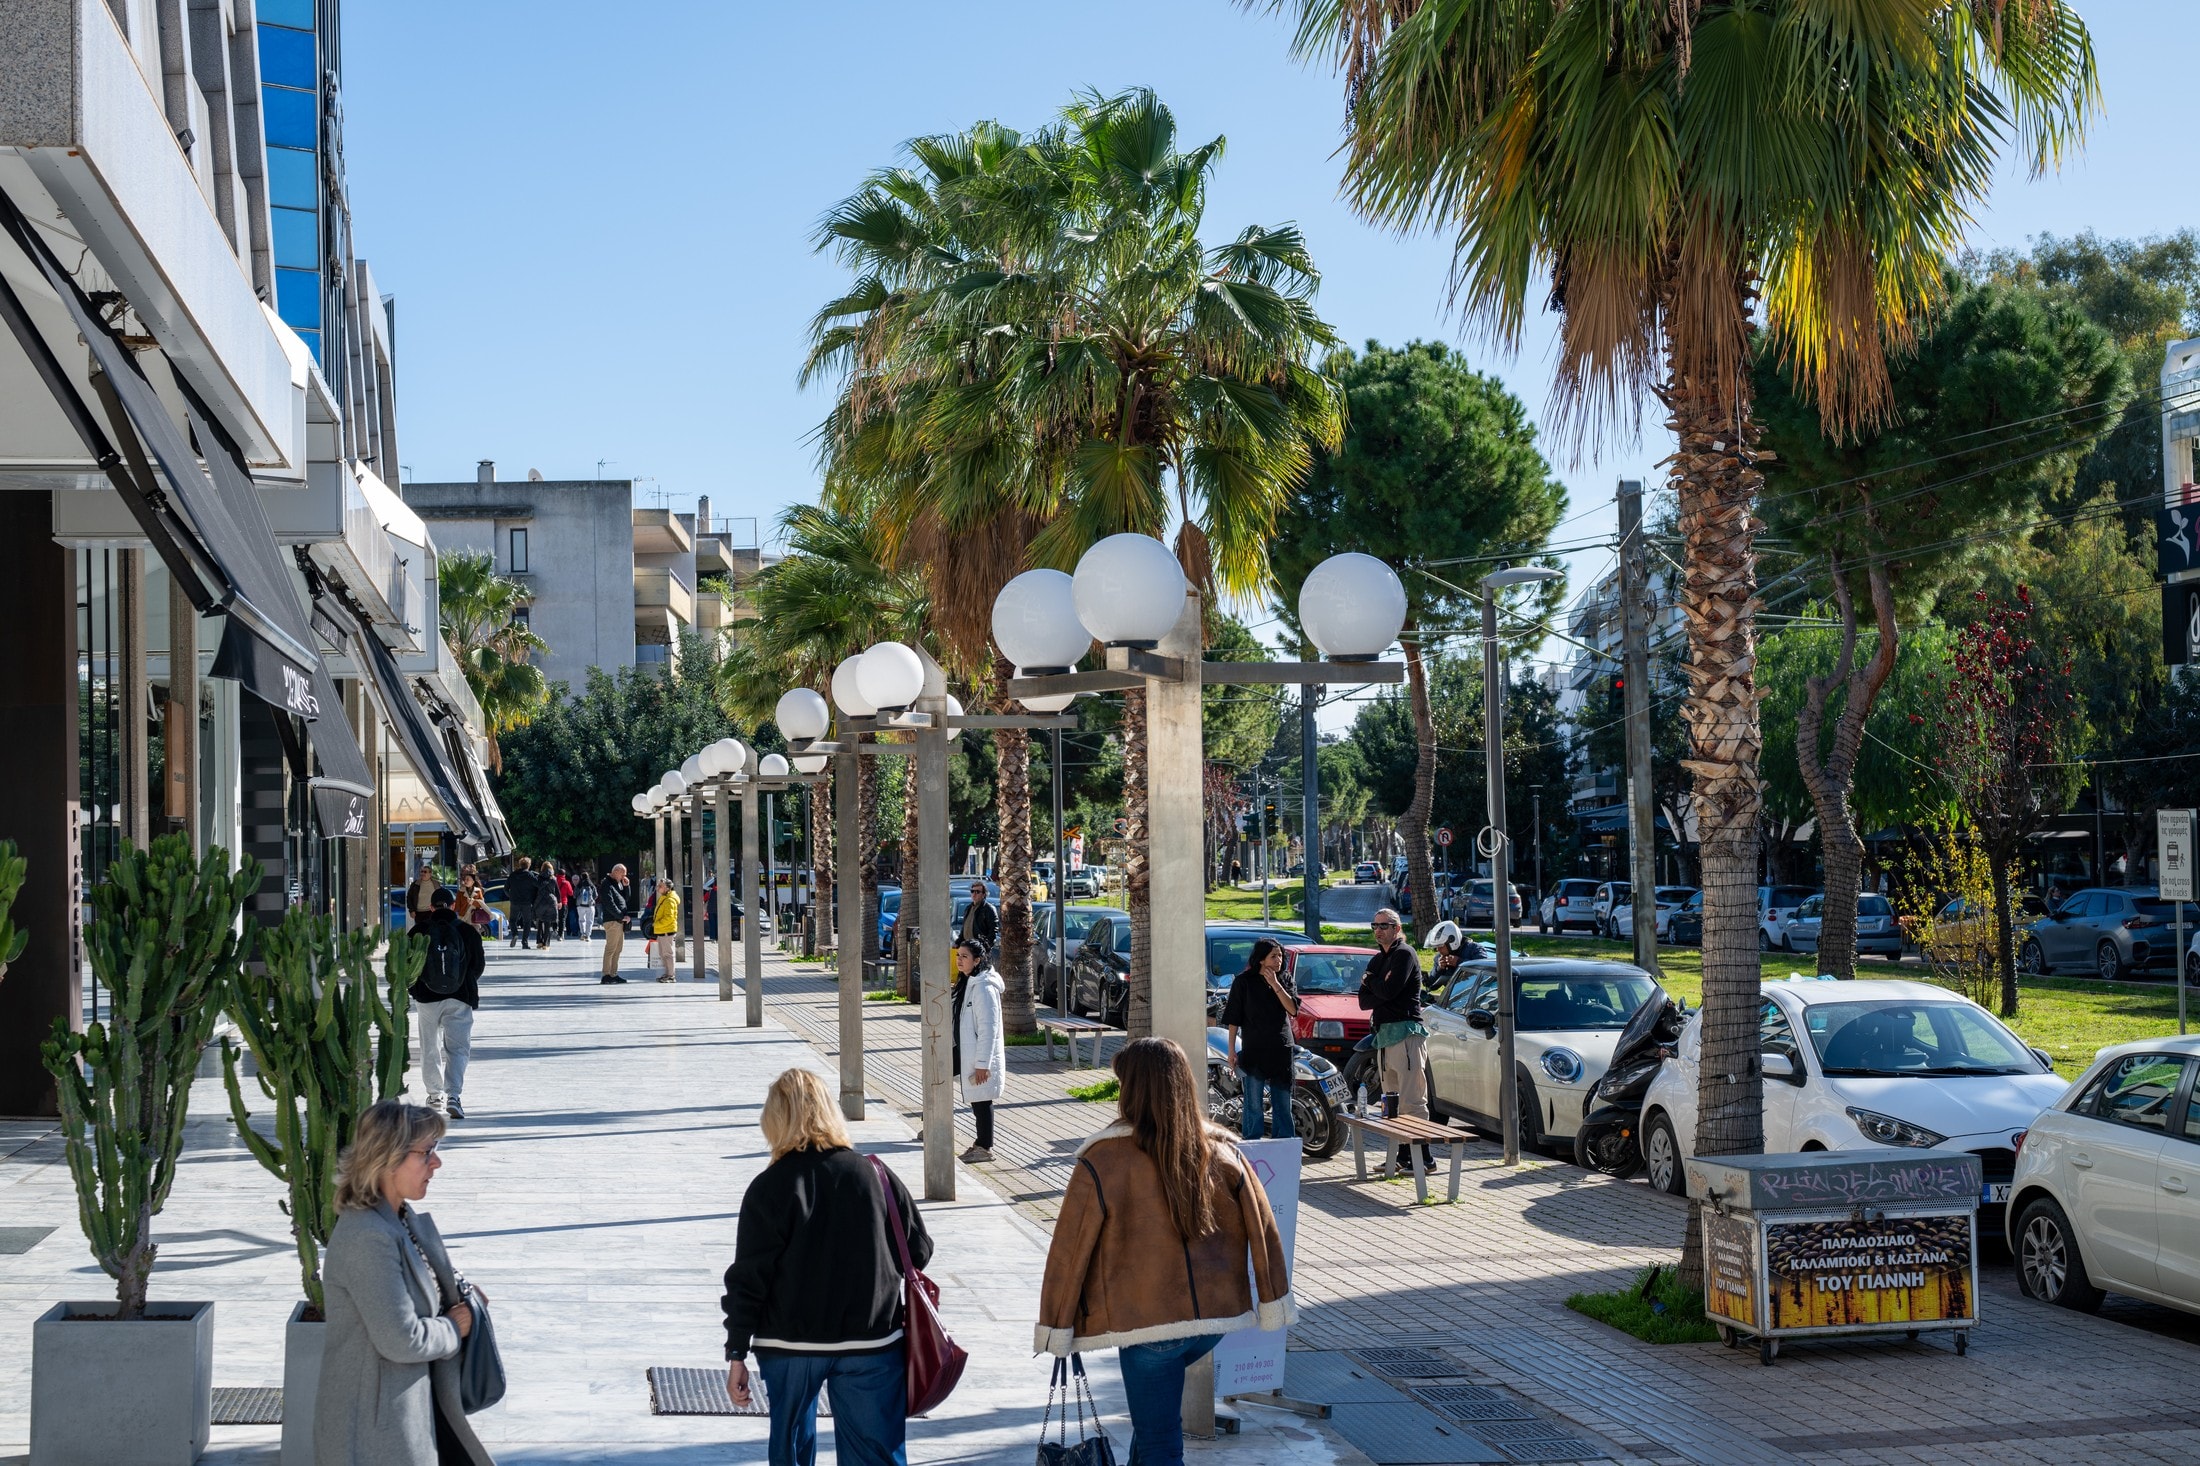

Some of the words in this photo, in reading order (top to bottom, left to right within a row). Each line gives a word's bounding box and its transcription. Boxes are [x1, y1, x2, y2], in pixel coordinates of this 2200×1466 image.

[1333, 1088, 1350, 1101] 755
[1822, 1234, 1916, 1250] ΠΑΡΑΔΟΣΙΑΚΟ
[1790, 1255, 1871, 1271] ΚΑΛΑΜΠΟΚΙ
[1874, 1255, 1885, 1266] &
[1887, 1252, 1949, 1265] ΚΑΣΤΑΝΑ
[1815, 1274, 1852, 1292] ΤΟΥ
[1858, 1271, 1925, 1290] ΓΙΑΝΝΗ
